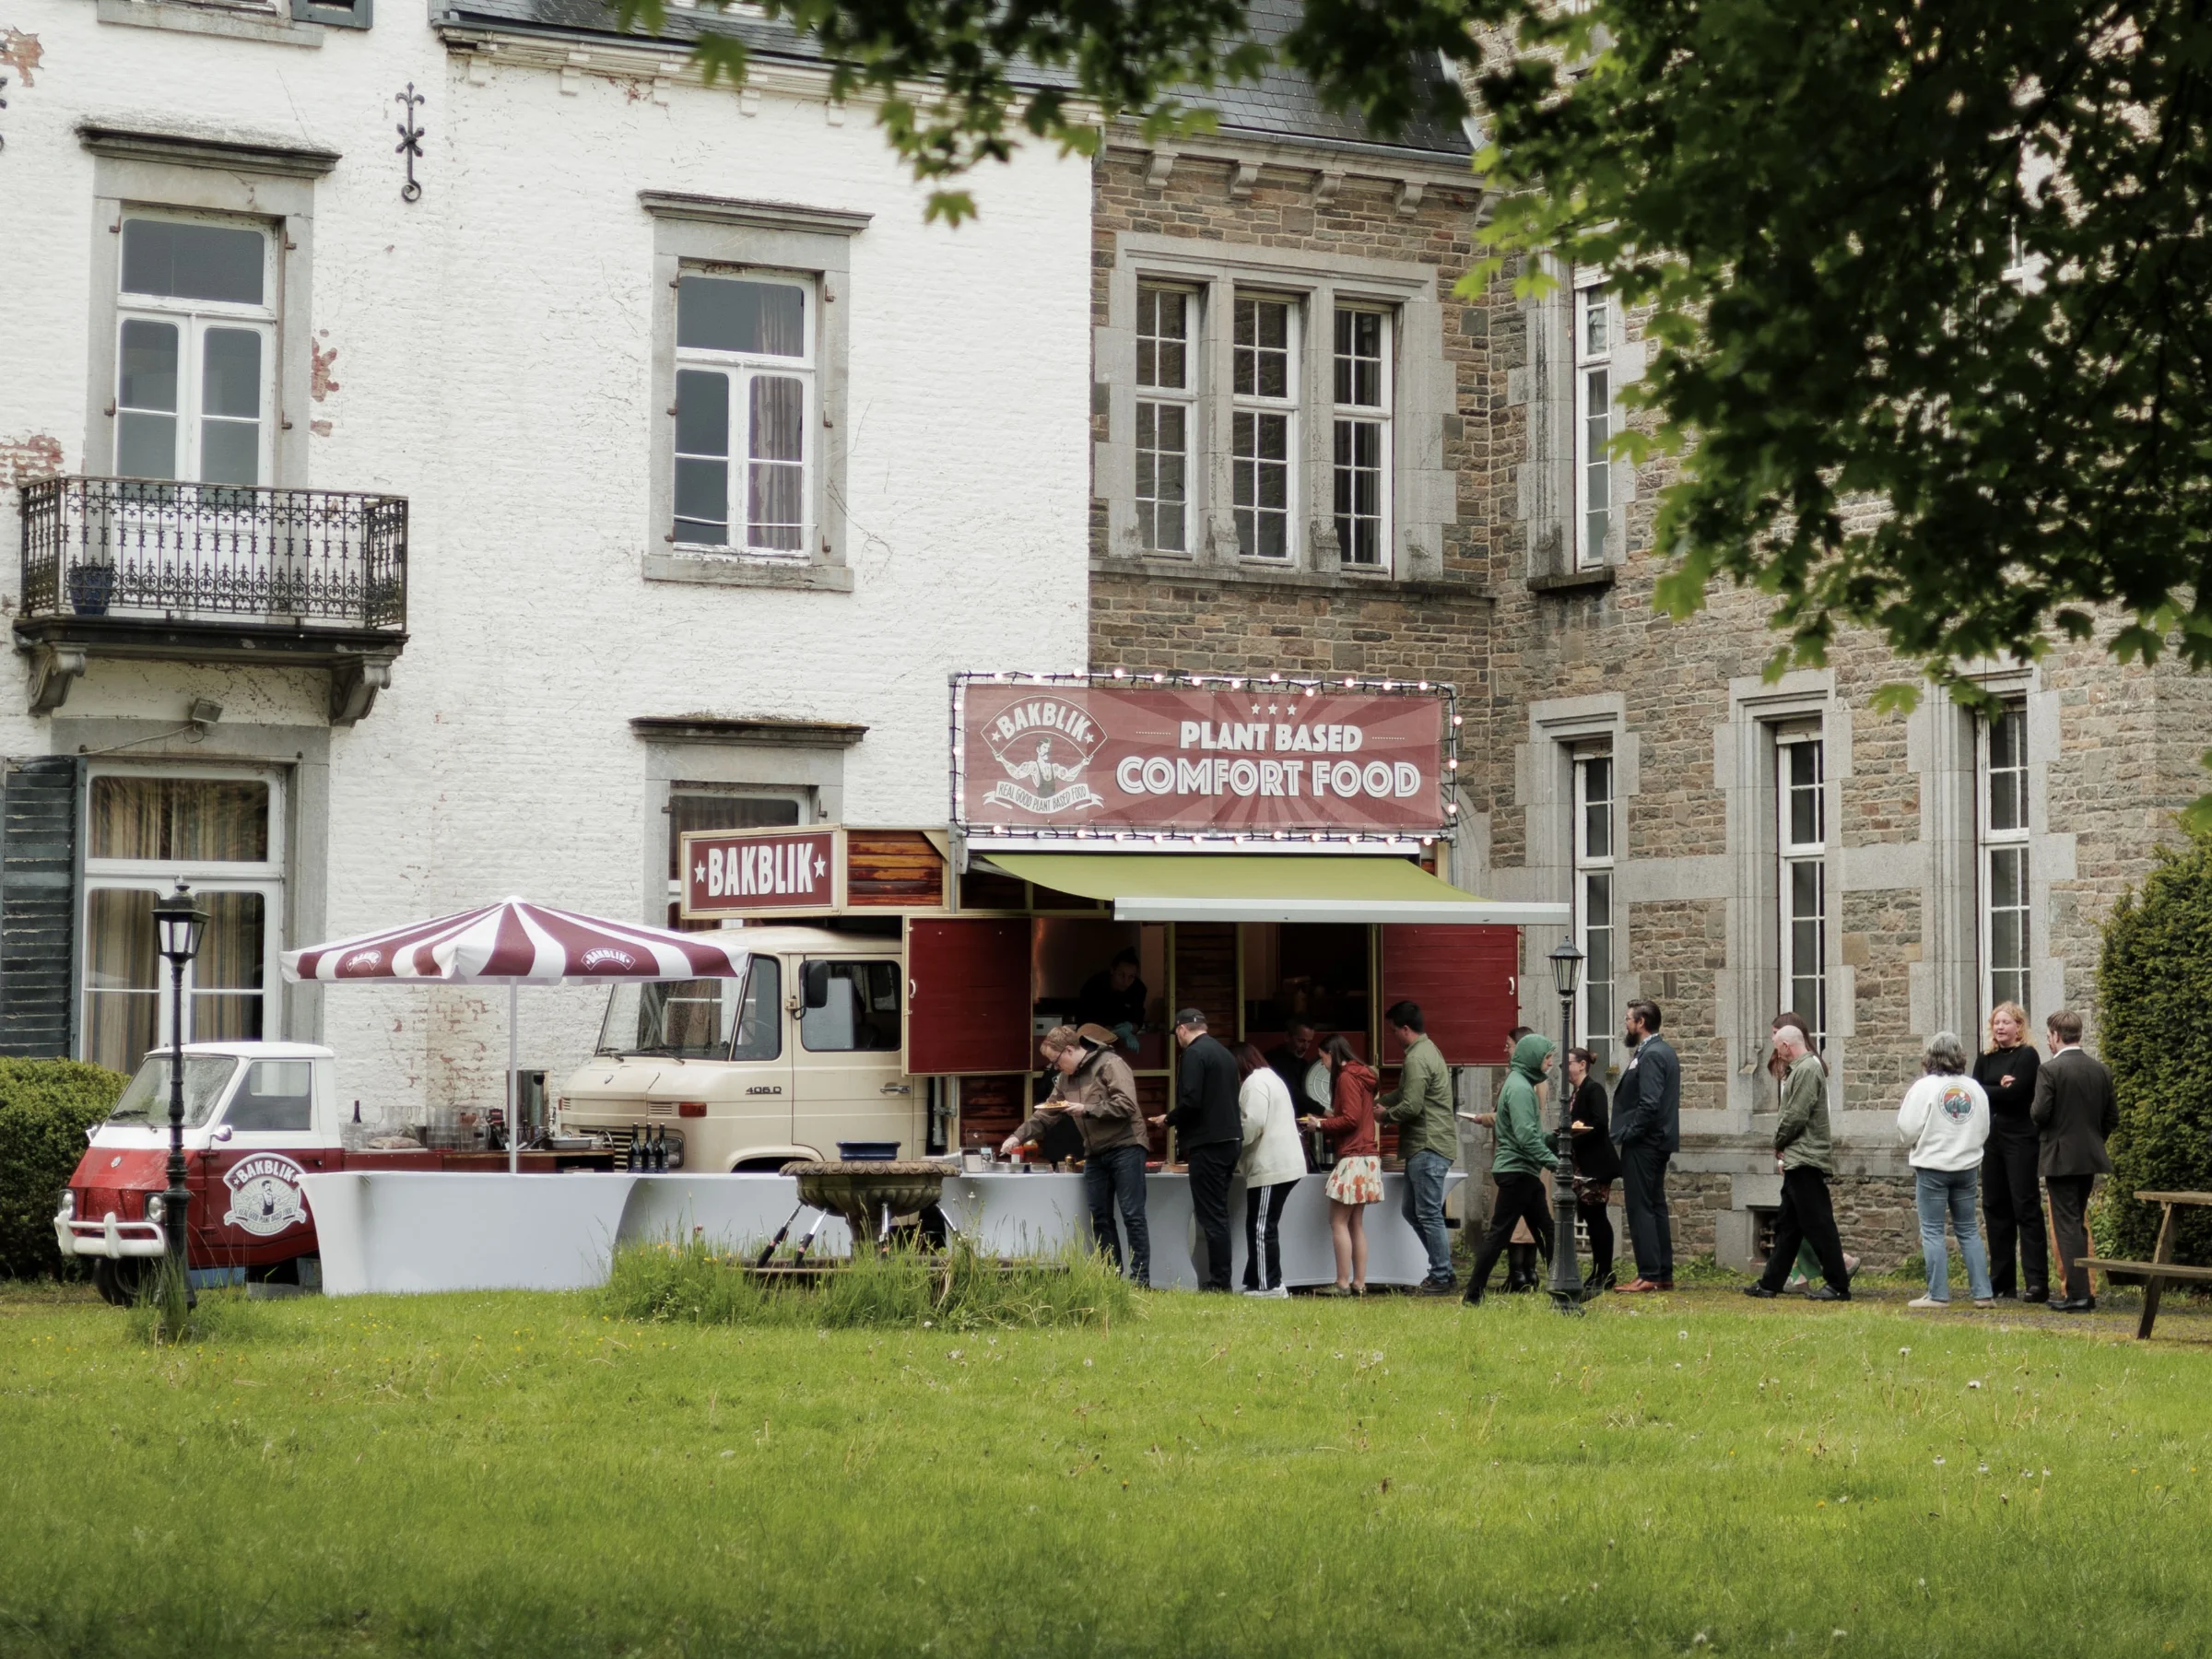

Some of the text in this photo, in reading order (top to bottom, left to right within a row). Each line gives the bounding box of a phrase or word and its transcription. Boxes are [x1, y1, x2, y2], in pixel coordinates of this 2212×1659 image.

[996, 702, 1091, 742] BAKBLIK
[1181, 721, 1363, 752] PLANT BASED
[1116, 756, 1421, 797] COMFORT FOOD
[998, 783, 1087, 811] REAL GOOD PLANT BASED FOOD
[708, 843, 813, 897] BAKBLIK
[236, 1159, 295, 1183] BAKBLIK
